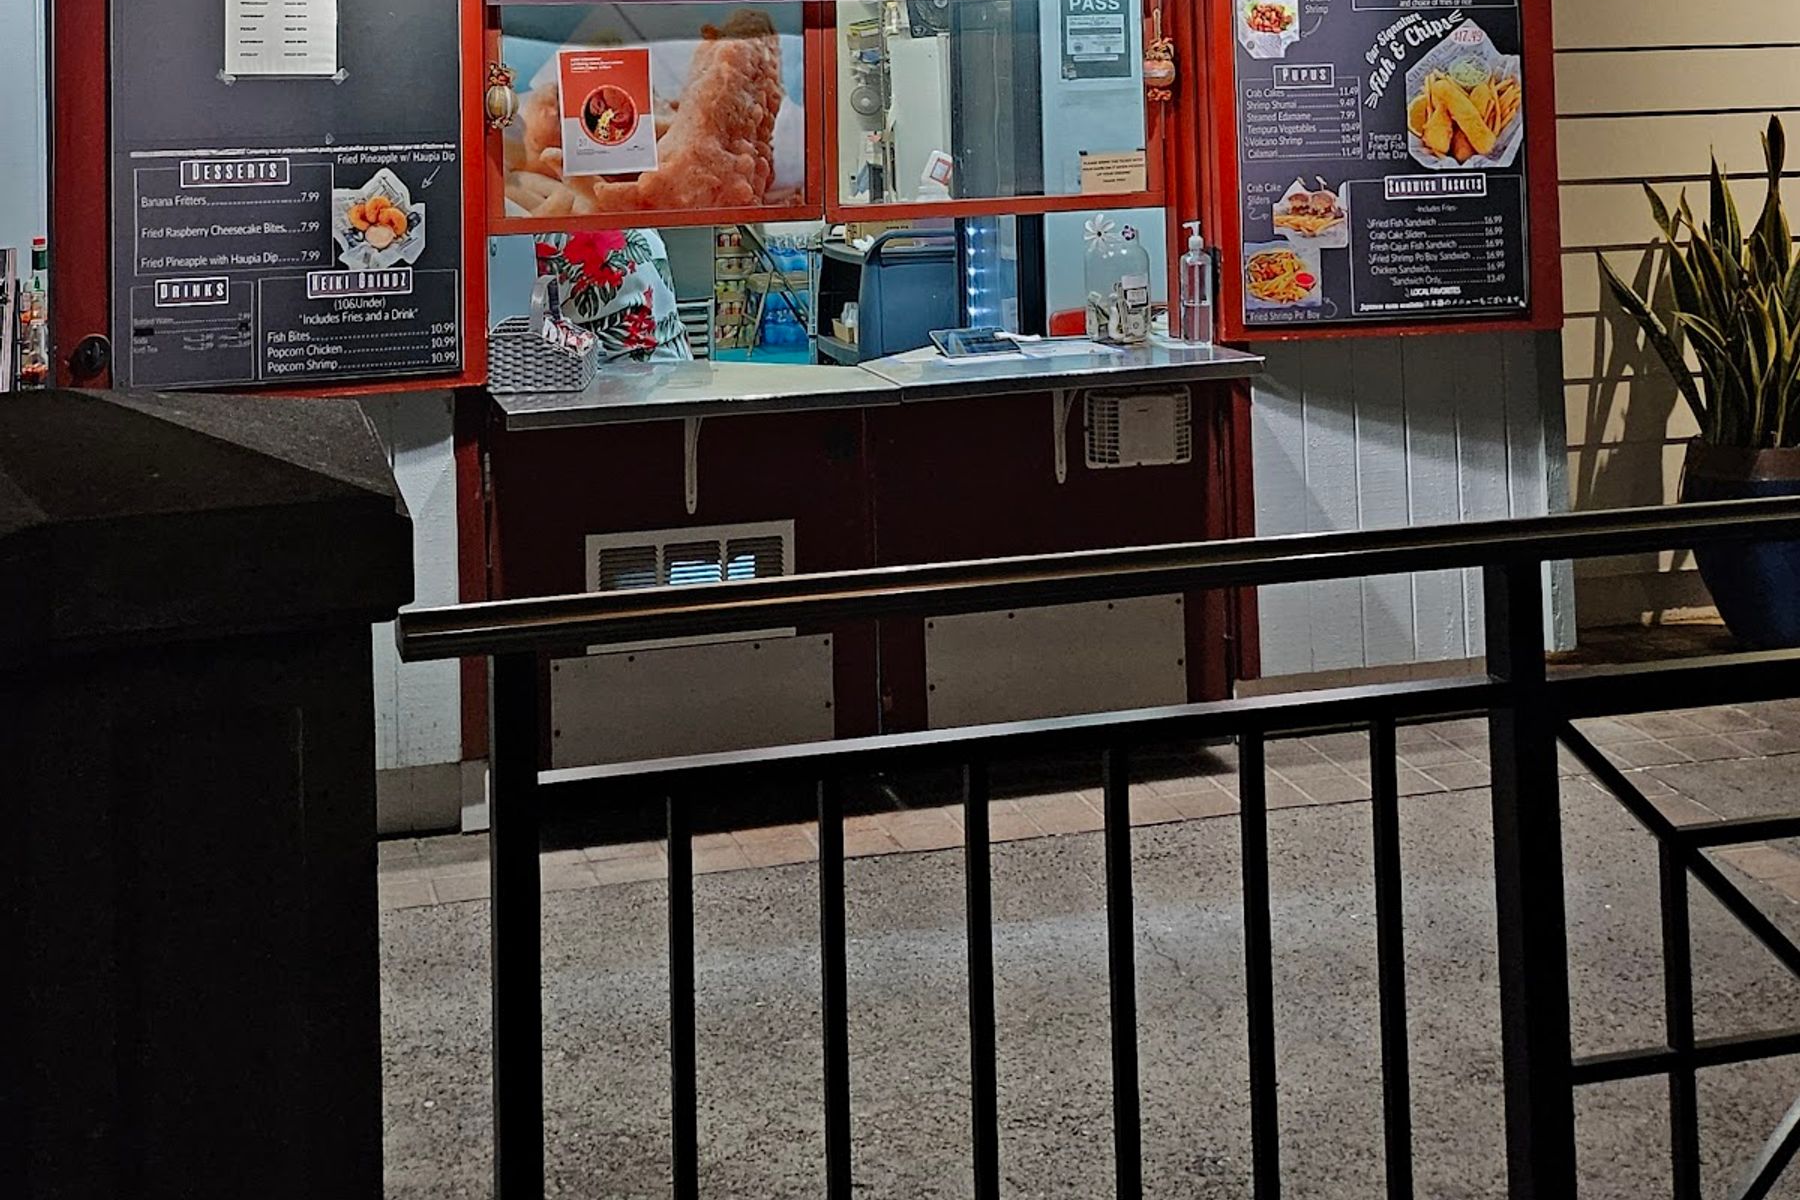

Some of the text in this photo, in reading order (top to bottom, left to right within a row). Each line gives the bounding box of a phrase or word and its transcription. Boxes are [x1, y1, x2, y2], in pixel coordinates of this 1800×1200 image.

[1305, 4, 1329, 14] Shrimp
[1365, 44, 1380, 64] Our
[1377, 12, 1422, 46] Signature
[1369, 57, 1396, 97] Fish
[1389, 42, 1405, 60] &
[1405, 17, 1452, 46] Chips
[1282, 68, 1327, 81] PUPUS
[1368, 141, 1406, 151] Fried Fish
[337, 154, 358, 164] Fried
[360, 153, 398, 165] Pineapple
[442, 151, 456, 163] Dip
[1366, 150, 1408, 161] of the Day
[192, 162, 278, 181] DESSERTS
[1247, 183, 1281, 193] Crab Cake
[141, 192, 320, 208] Banana Fritters 7.99
[141, 222, 320, 240] Fried Raspberry Cheesecake Bites 7.99
[141, 251, 320, 270] Fried Pineapple with Haupia Dip 7.99
[160, 282, 225, 299] DRINKS
[342, 311, 363, 322] Fries
[364, 310, 383, 322] and
[384, 312, 389, 320] a
[267, 323, 455, 343] Fish Bites 10.99
[267, 337, 456, 359] Popcorn Chicken 10.99
[267, 352, 456, 374] Popcorn Shrimp 10.99
